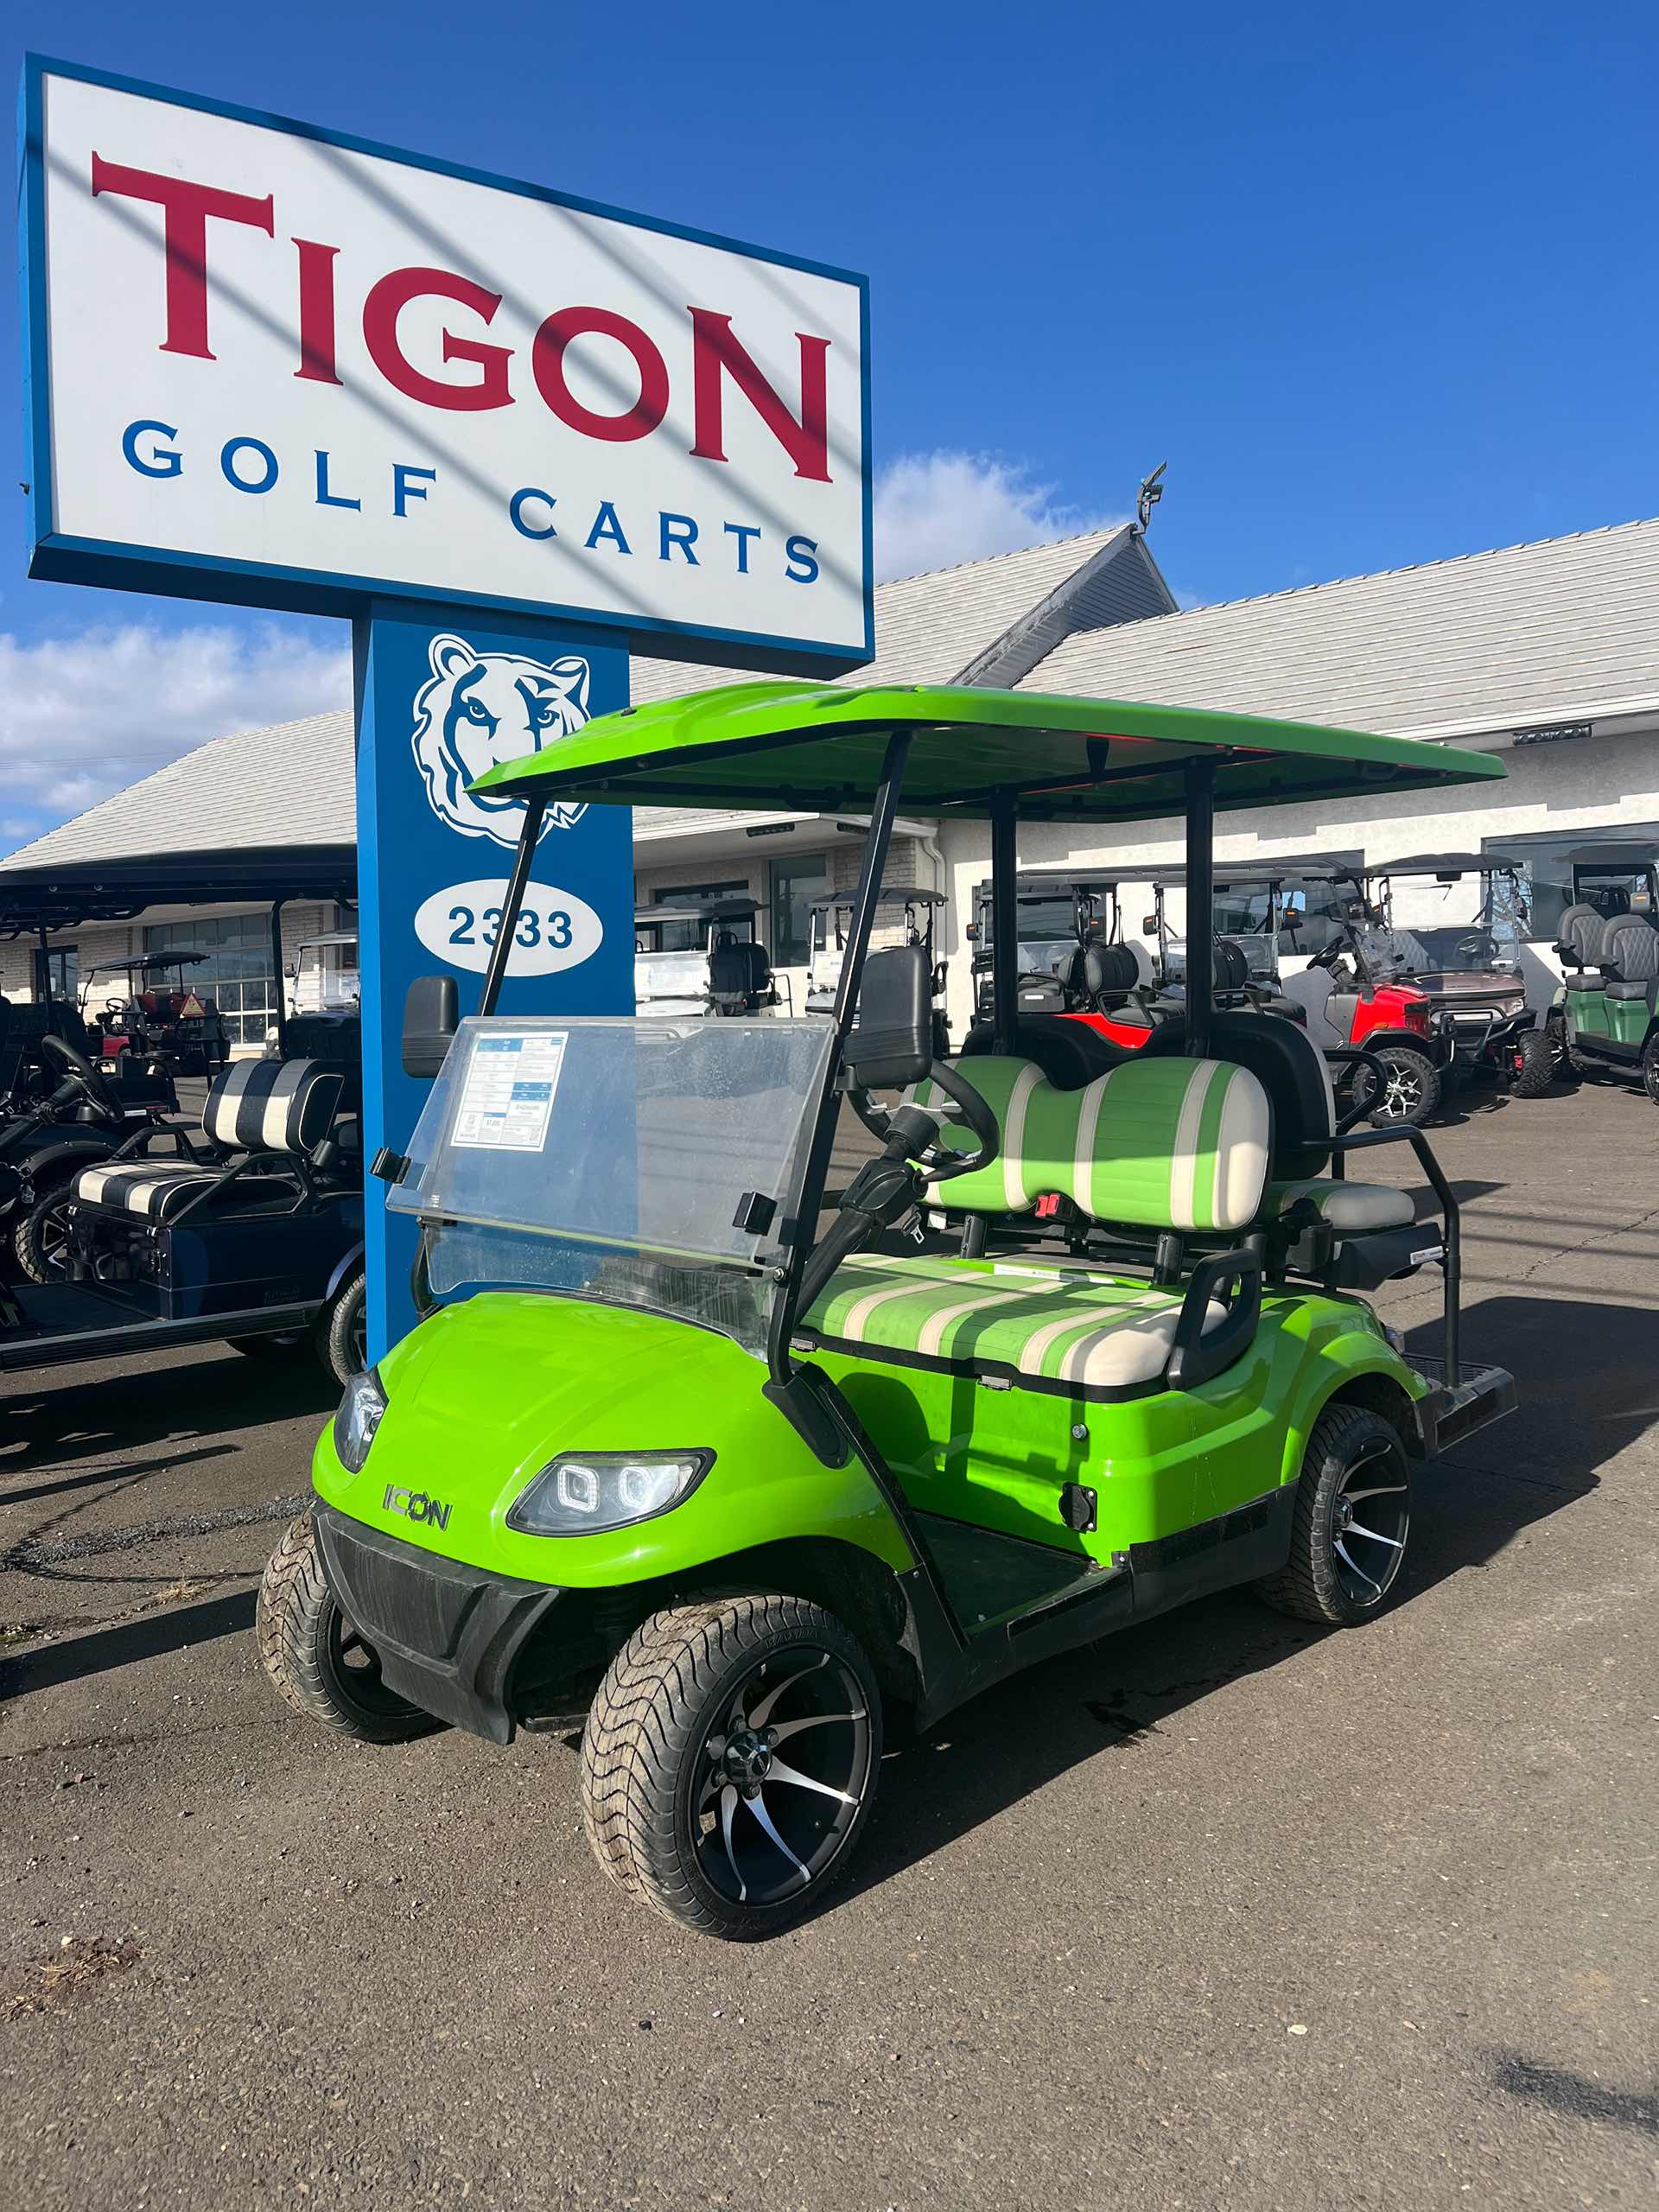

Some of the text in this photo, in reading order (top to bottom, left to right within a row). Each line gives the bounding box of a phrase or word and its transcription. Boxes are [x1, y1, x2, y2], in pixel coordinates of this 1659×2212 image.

[92, 149, 834, 484] TIGON
[122, 420, 821, 584] GOLF CARTS
[448, 906, 573, 949] 2333
[382, 1483, 454, 1532] ICON
